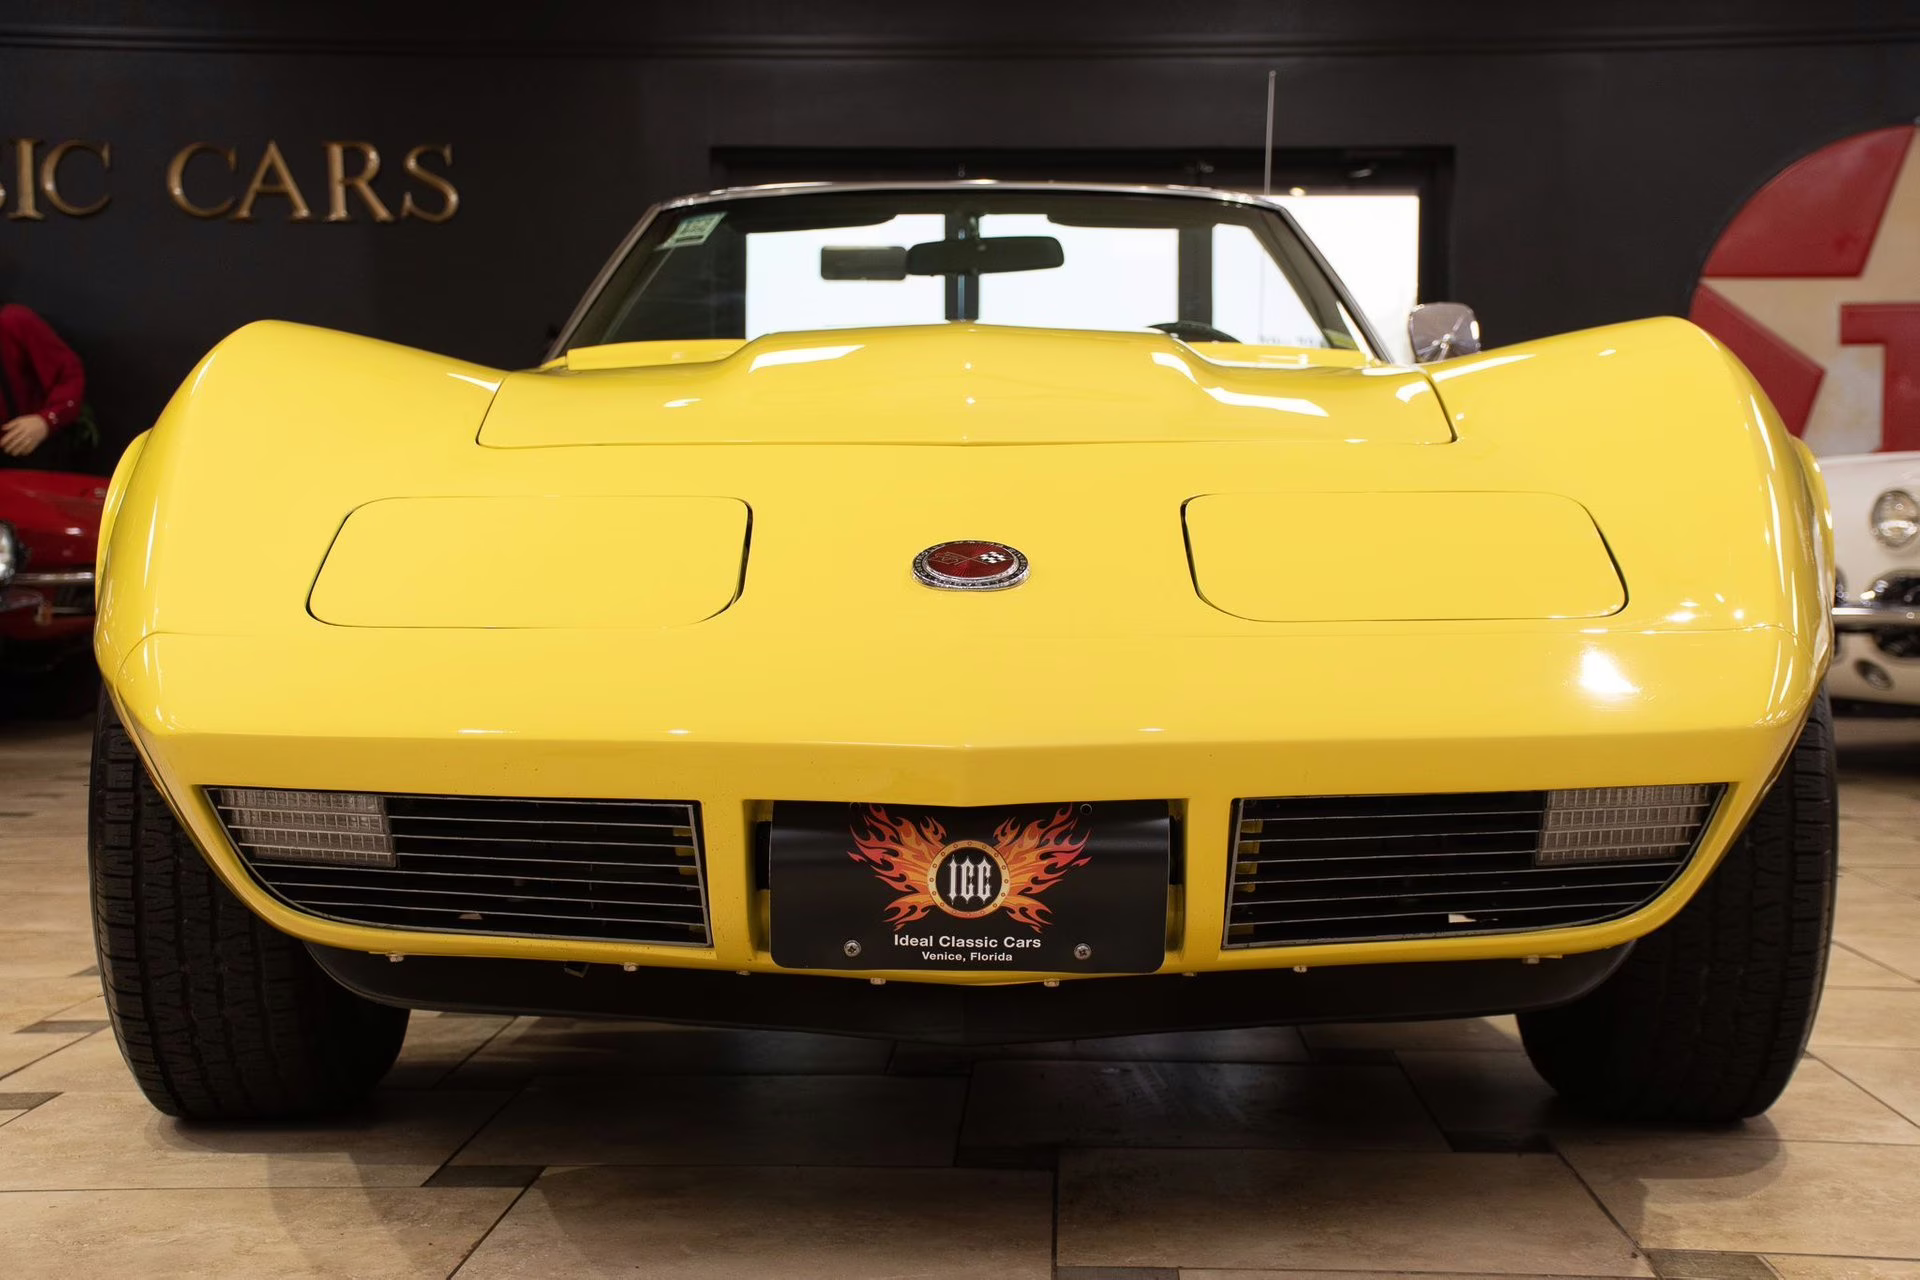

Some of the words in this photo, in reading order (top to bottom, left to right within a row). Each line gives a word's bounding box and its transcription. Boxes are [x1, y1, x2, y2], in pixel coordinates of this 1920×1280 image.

[0, 138, 112, 221] IC
[167, 139, 460, 224] CARS
[894, 934, 934, 948] Ideal
[939, 935, 999, 949] Classic
[1003, 936, 1042, 949] Cars
[921, 951, 967, 963] Venice,
[970, 952, 1013, 963] Florida
